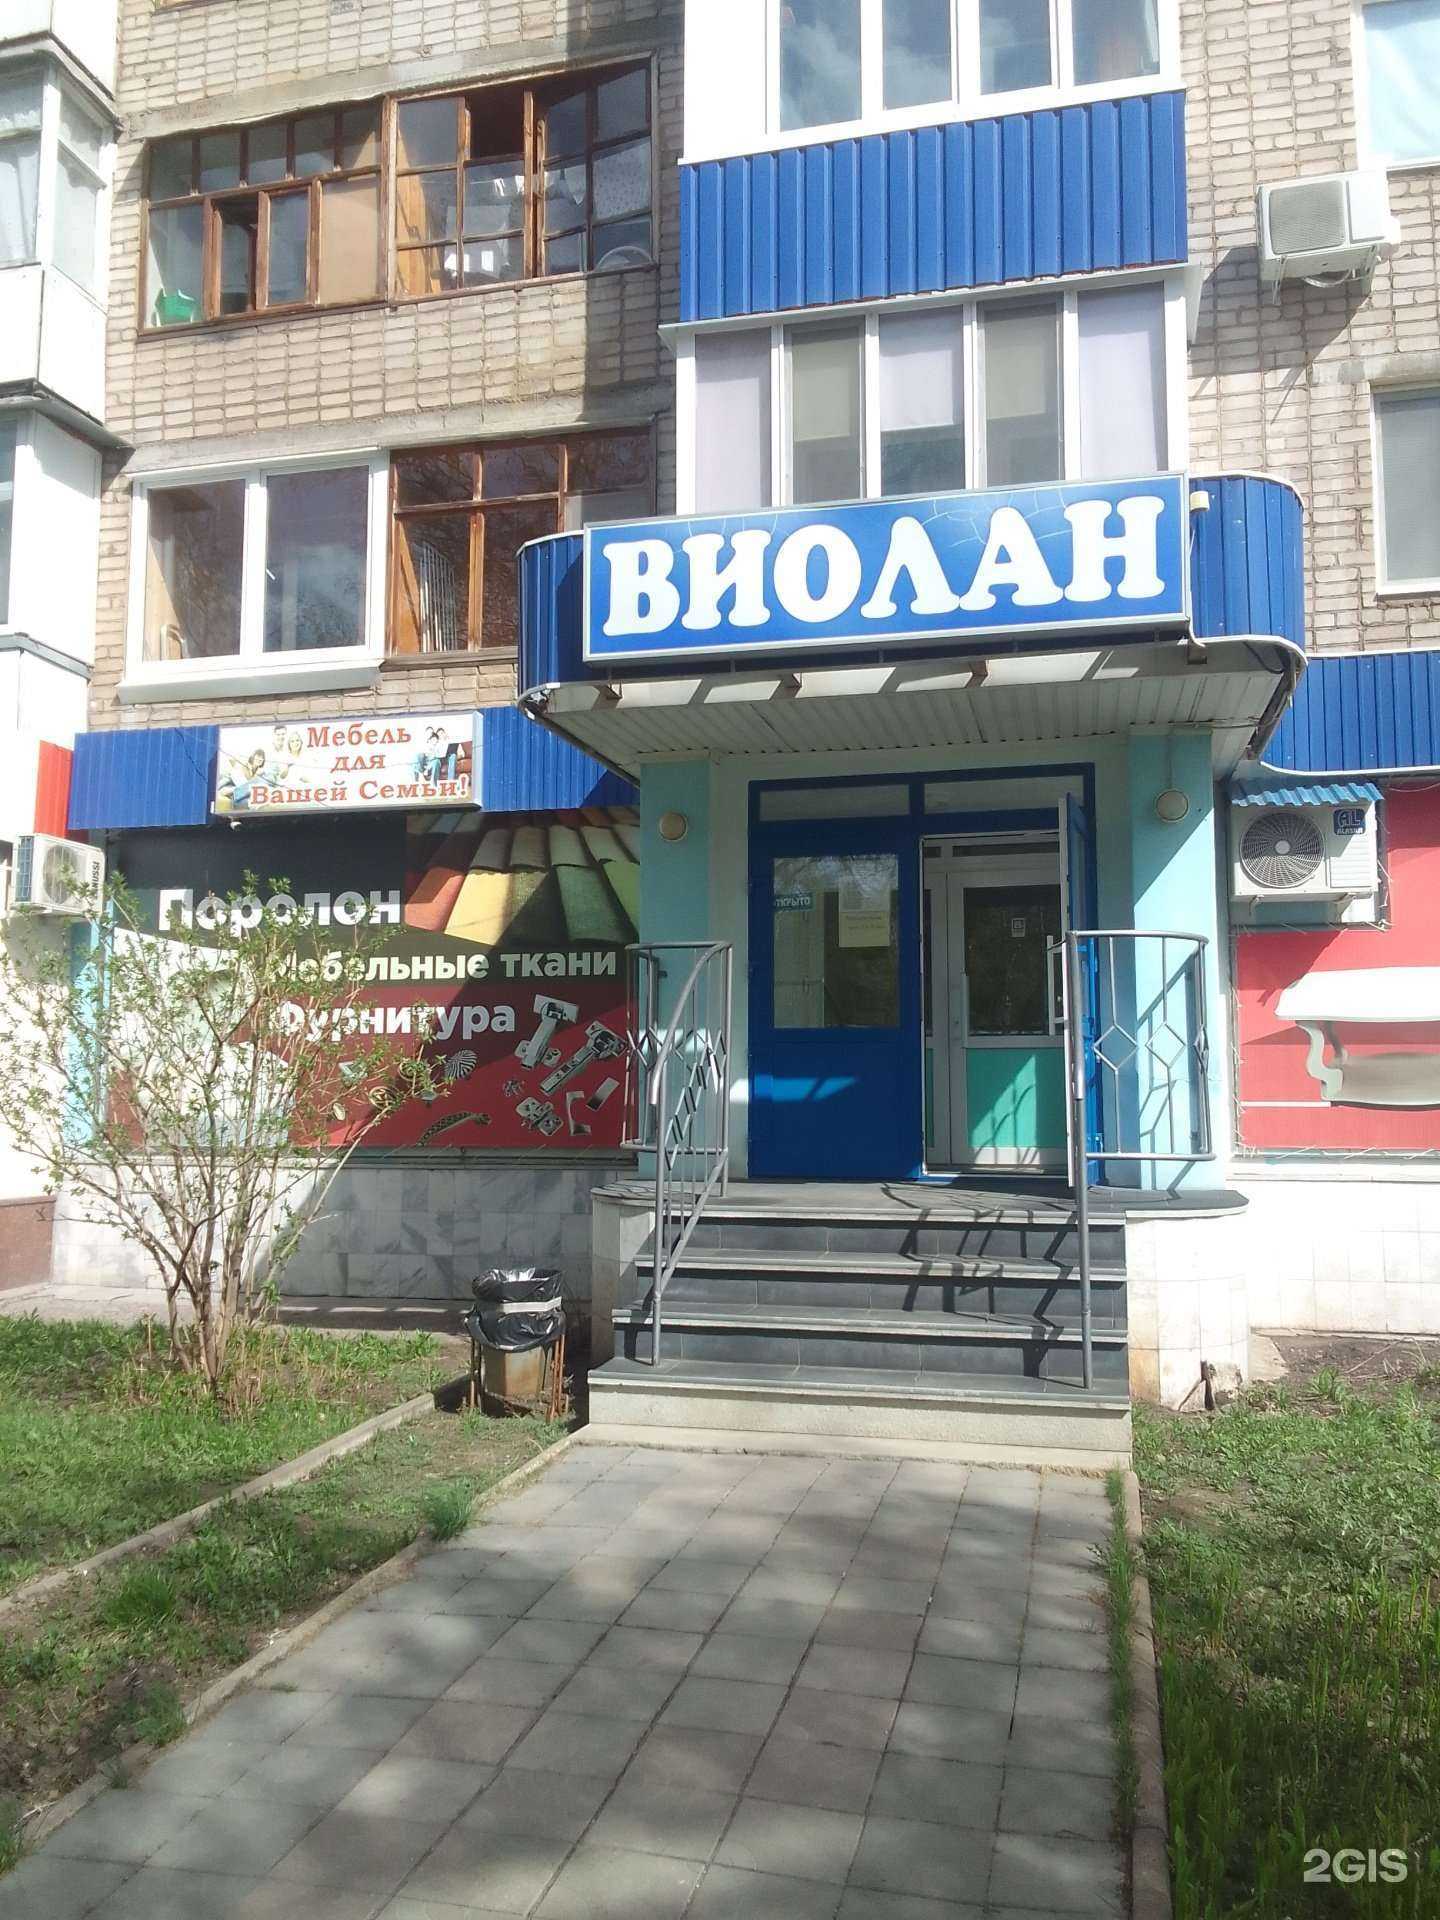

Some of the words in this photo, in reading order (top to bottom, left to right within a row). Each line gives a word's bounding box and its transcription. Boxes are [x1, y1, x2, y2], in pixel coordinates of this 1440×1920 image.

[602, 496, 1166, 637] ВИОЛАН
[306, 722, 412, 749] Мебель
[330, 754, 386, 774] для
[250, 780, 347, 805] Вашей
[358, 772, 469, 801] Семьи!
[158, 888, 401, 938] Поролон
[501, 951, 617, 979] ткани
